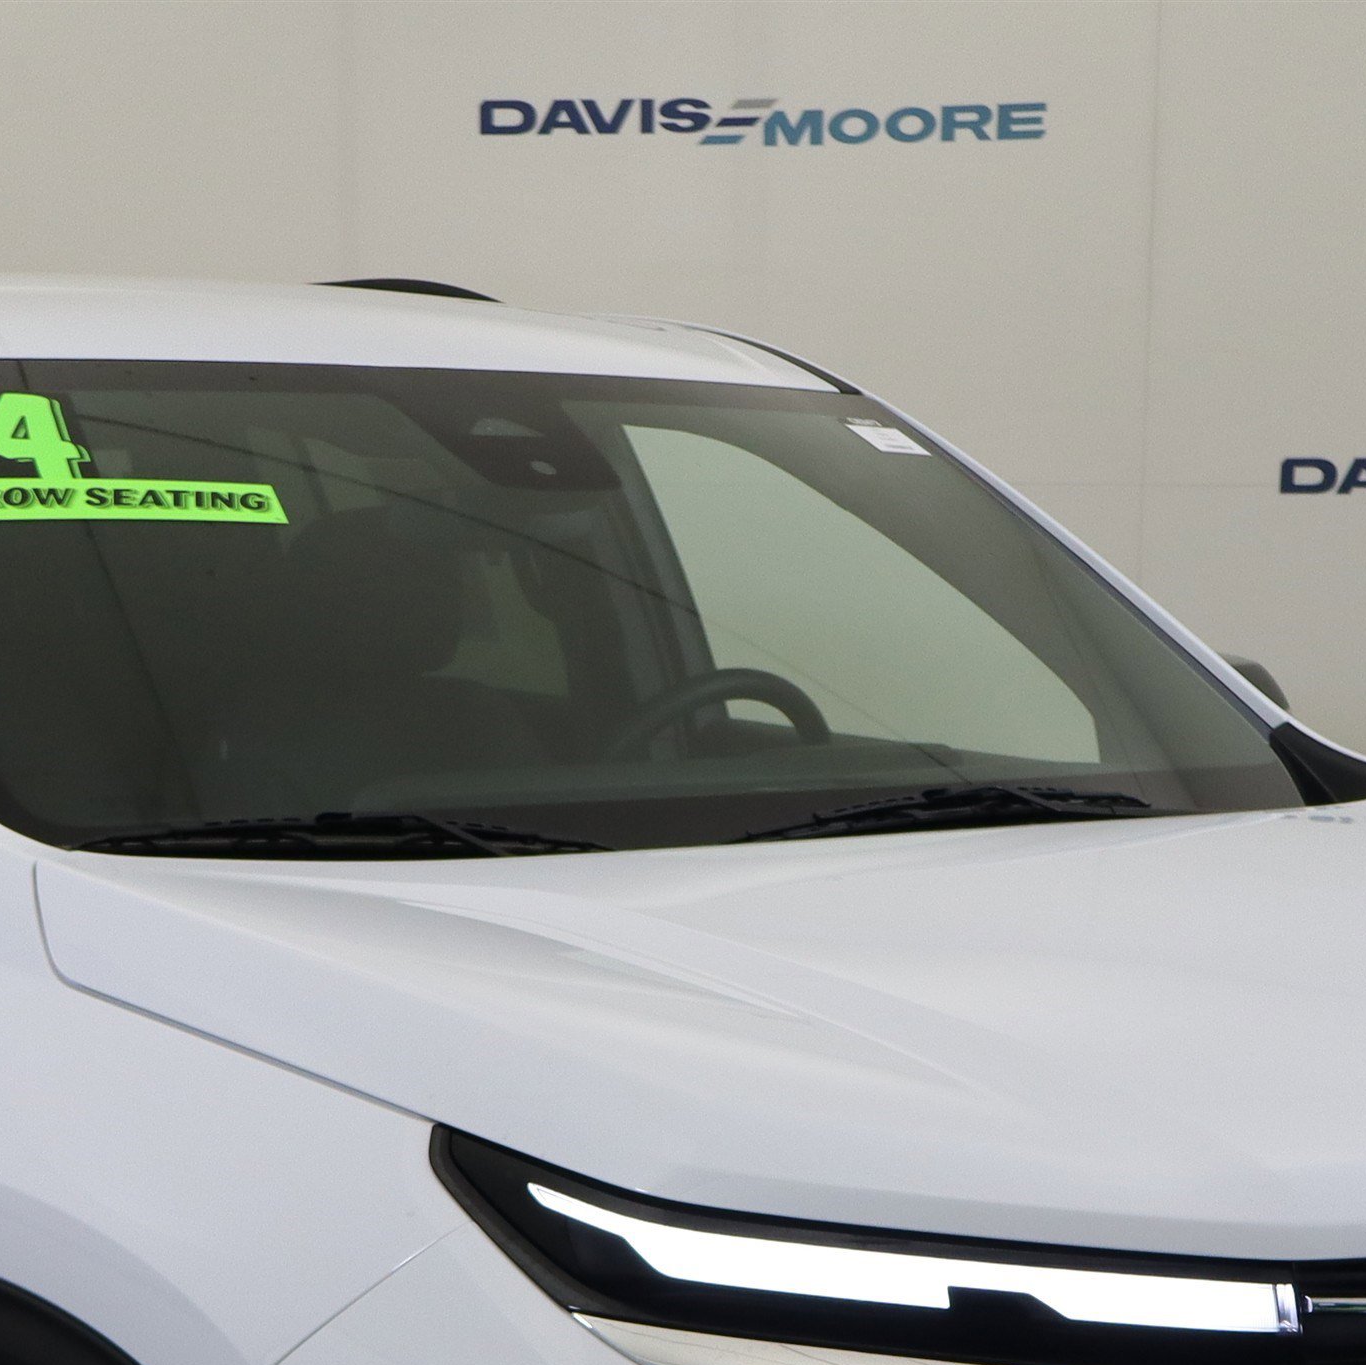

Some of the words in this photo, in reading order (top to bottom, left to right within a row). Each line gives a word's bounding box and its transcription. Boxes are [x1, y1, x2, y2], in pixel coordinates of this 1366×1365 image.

[479, 97, 712, 136] DAVIS
[763, 102, 1047, 147] MOORE
[84, 487, 271, 513] SEATING
